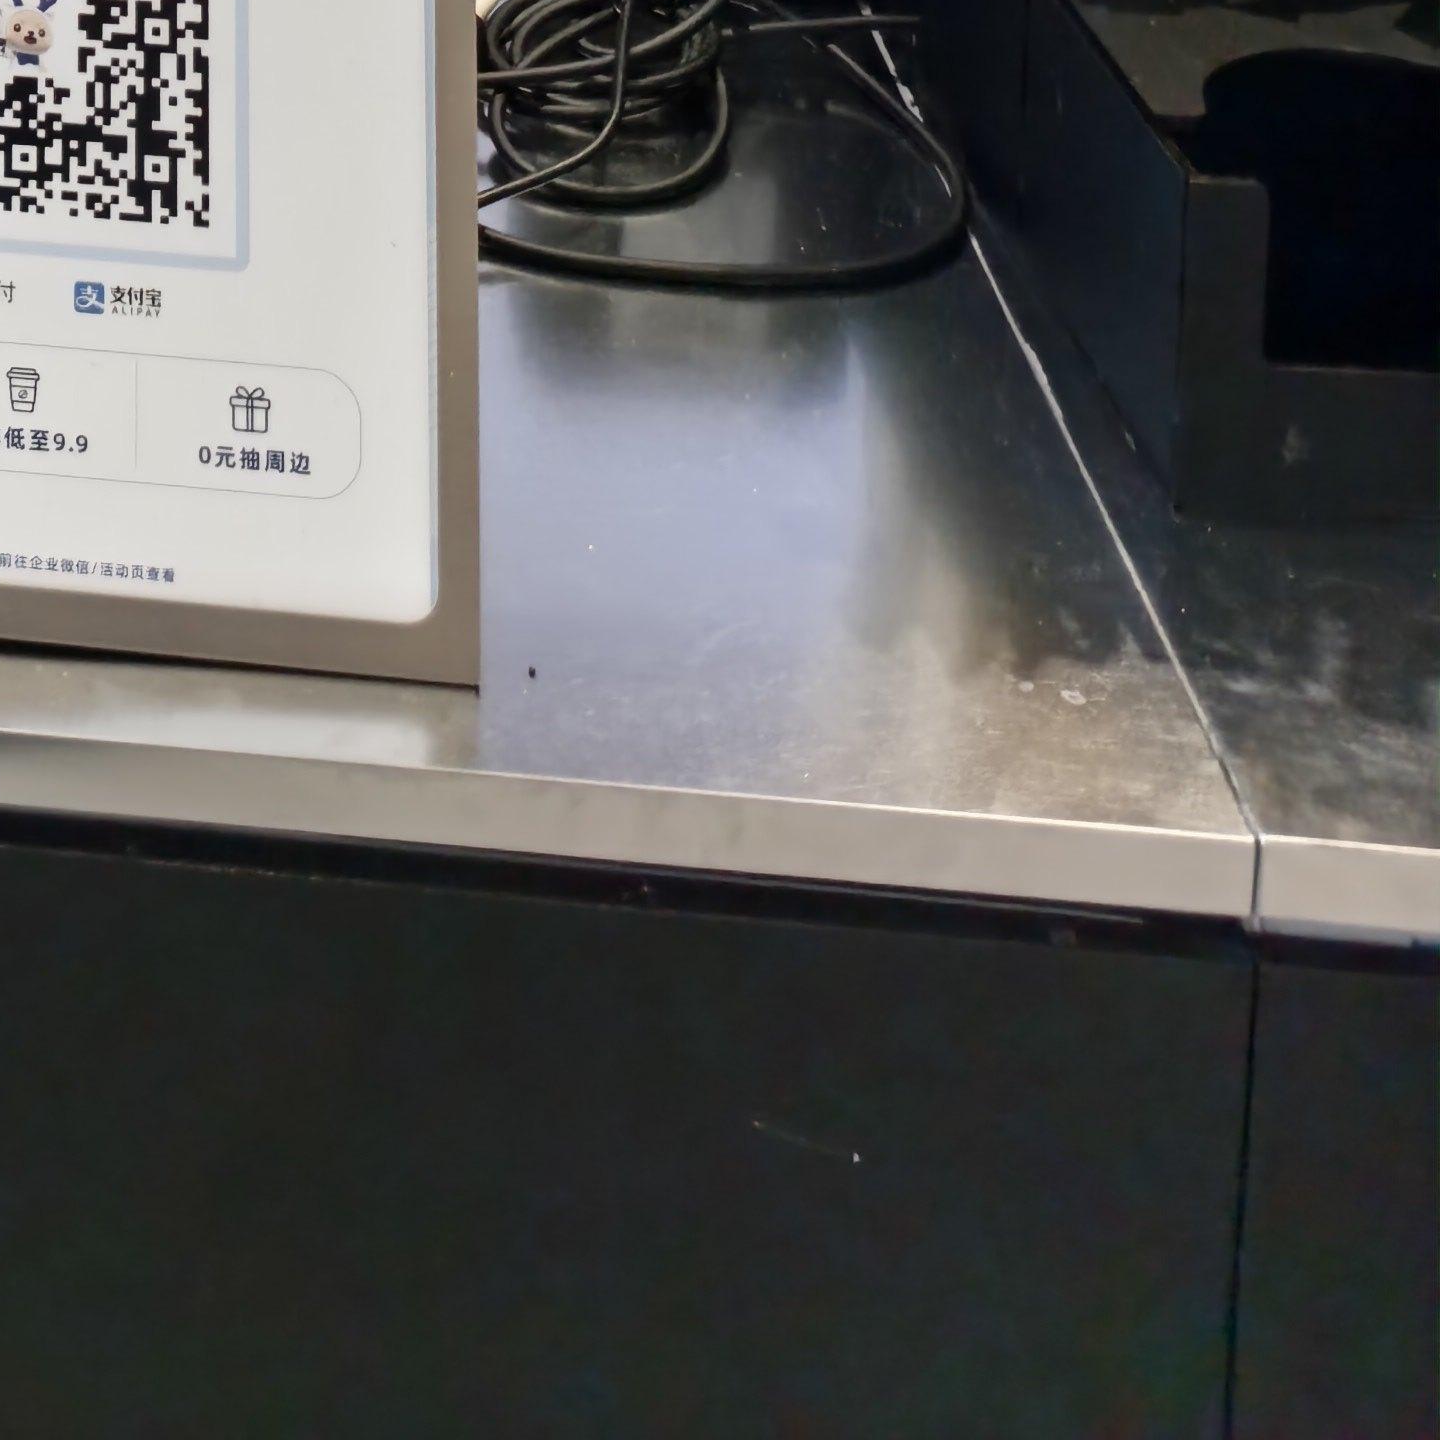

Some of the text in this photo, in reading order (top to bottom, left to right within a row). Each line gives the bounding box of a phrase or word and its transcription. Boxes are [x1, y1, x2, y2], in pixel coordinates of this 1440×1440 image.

[109, 284, 163, 307] 支付宝
[111, 306, 162, 318] ALIPAY
[198, 445, 311, 476] 0元抽周边
